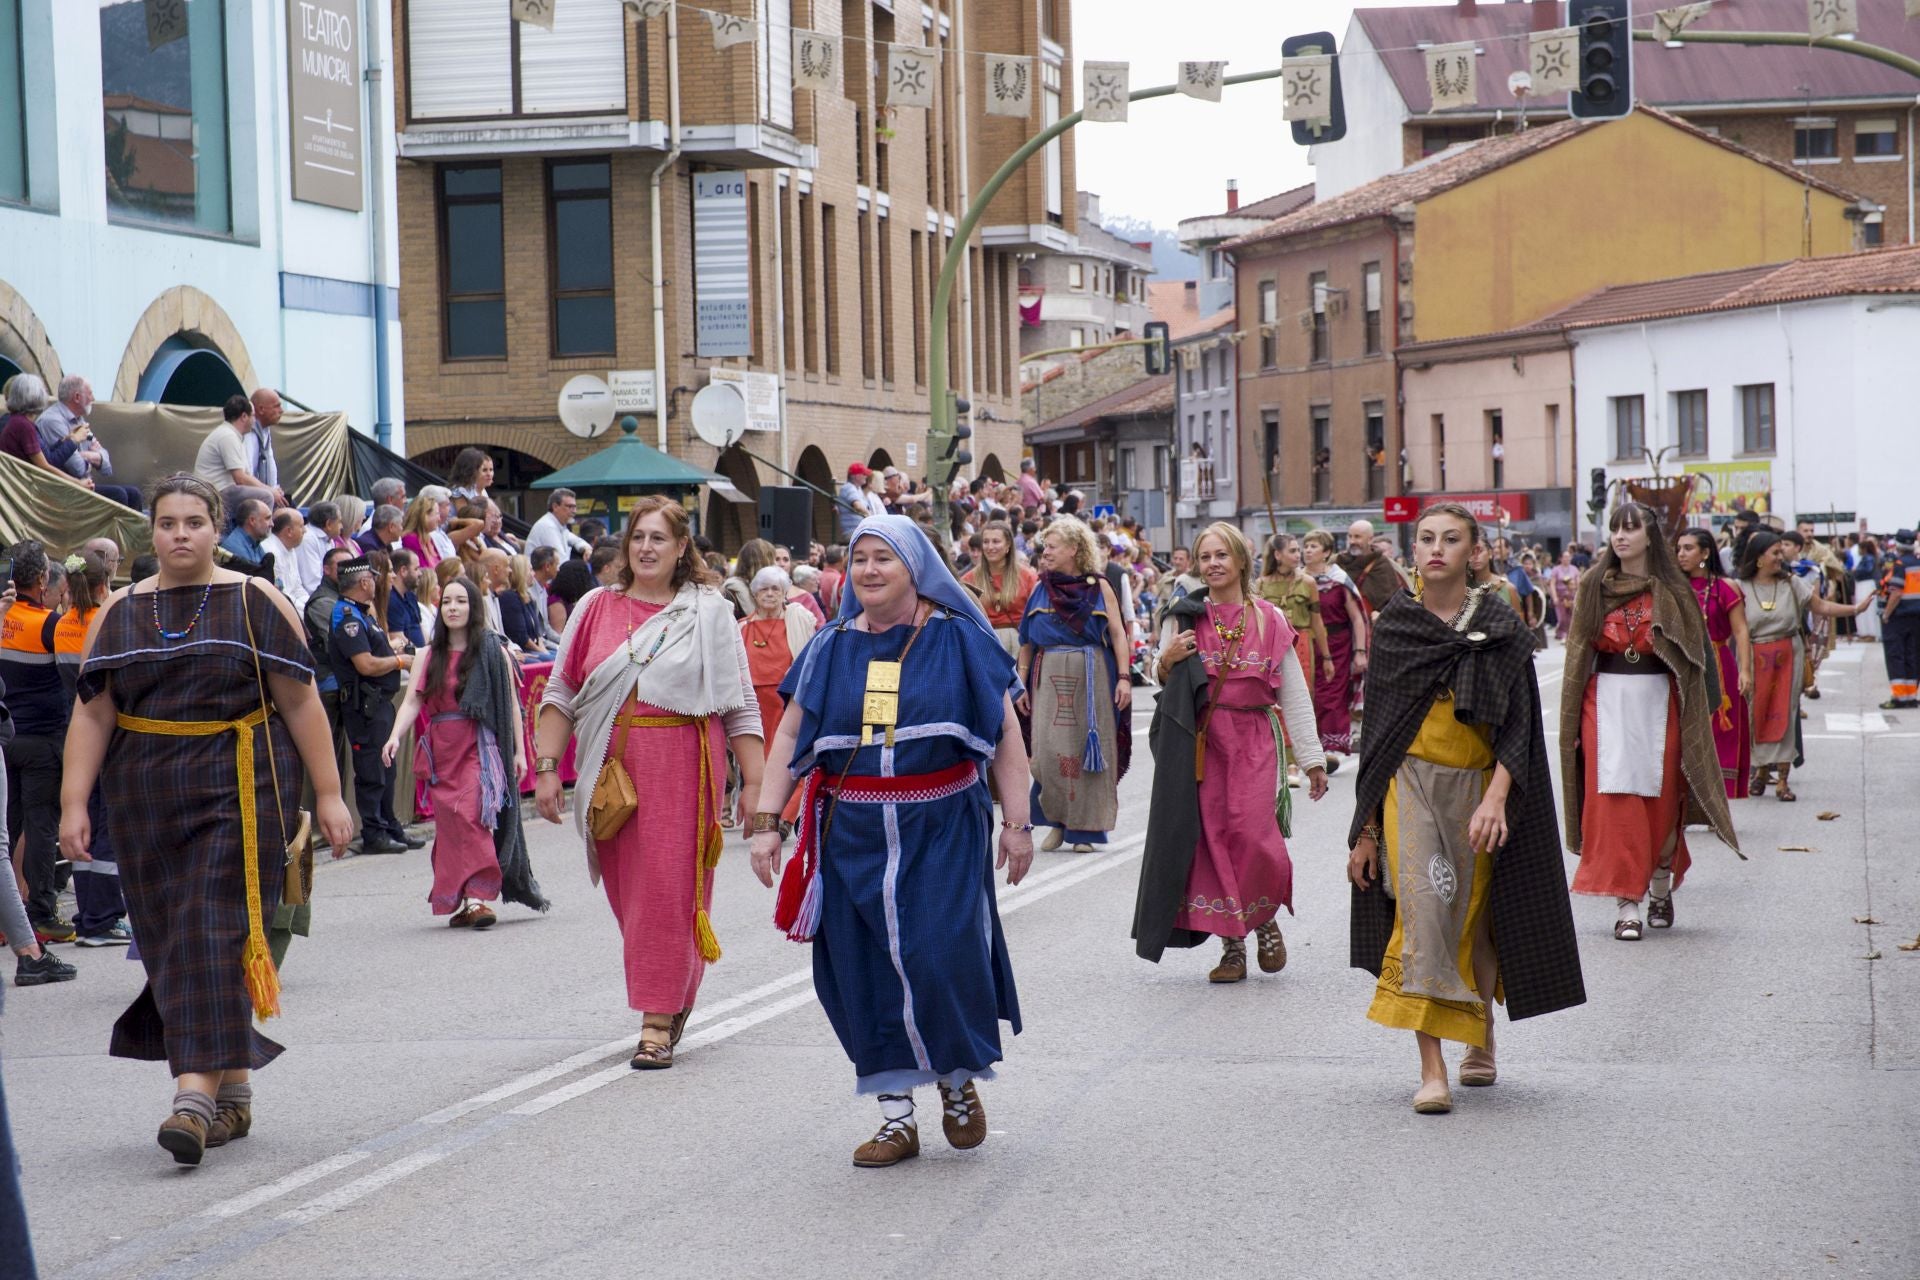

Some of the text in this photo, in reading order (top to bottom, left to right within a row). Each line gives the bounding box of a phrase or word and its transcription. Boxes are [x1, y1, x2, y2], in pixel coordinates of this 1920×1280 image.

[299, 1, 351, 52] TEATRO
[302, 48, 352, 86] MUNICIPAL
[700, 313, 747, 321] arquitectura
[612, 388, 652, 396] NAVAS DE
[617, 398, 649, 406] TOLOSA
